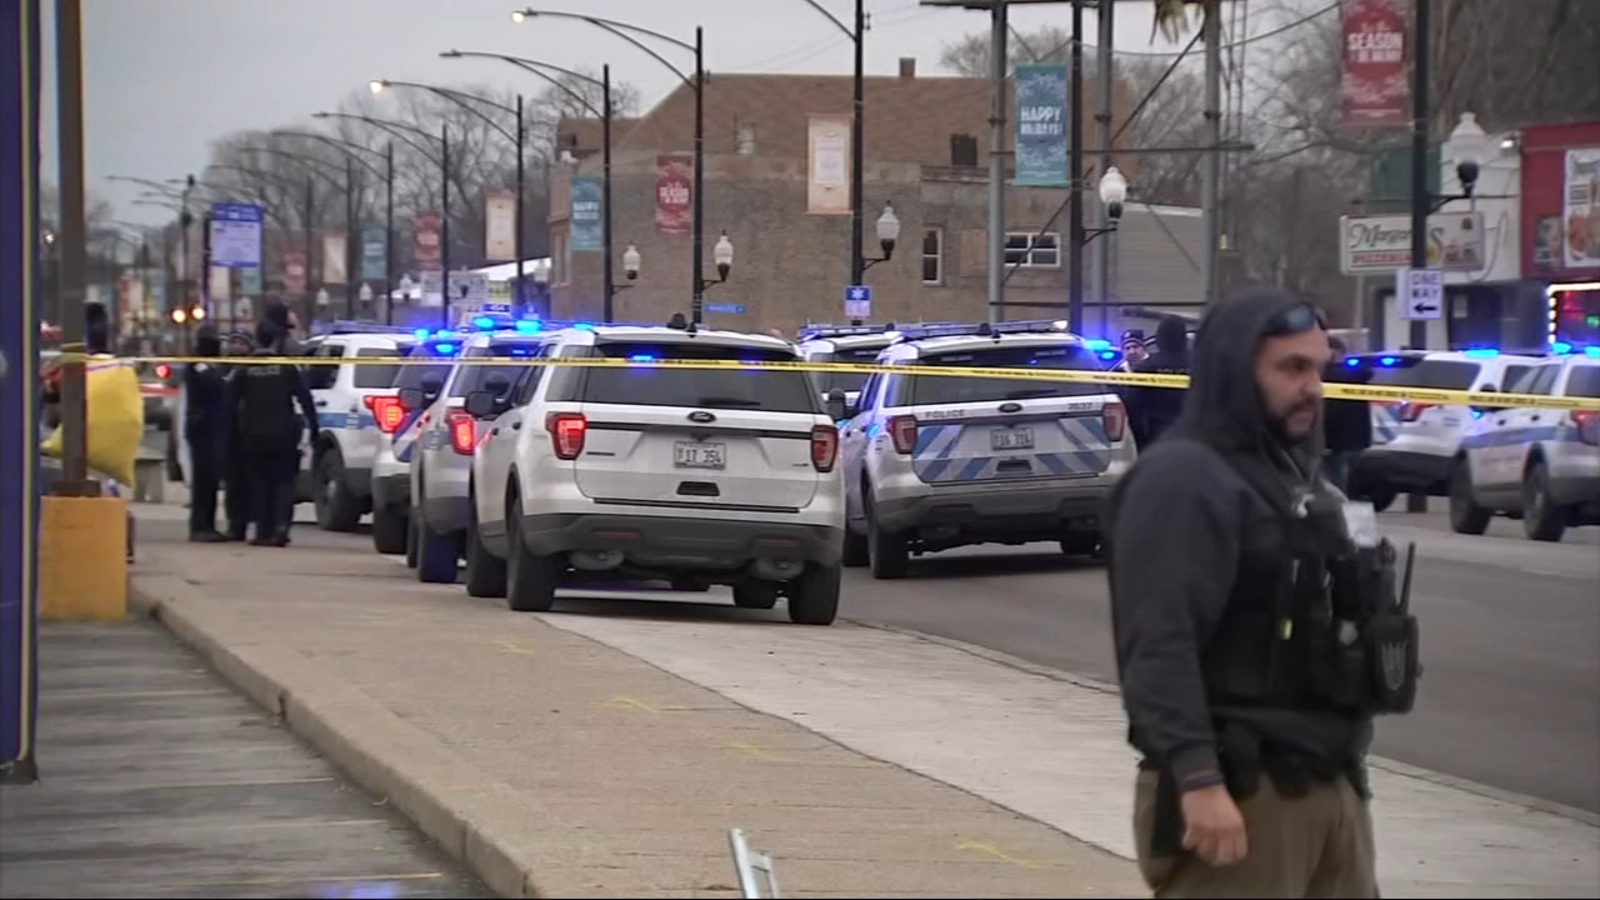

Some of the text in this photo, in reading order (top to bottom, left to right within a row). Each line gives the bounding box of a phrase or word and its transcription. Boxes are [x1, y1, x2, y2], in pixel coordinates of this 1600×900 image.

[1348, 32, 1403, 50] SEASON
[1020, 106, 1061, 121] HAPPY
[1412, 273, 1439, 285] ONE
[1412, 288, 1439, 300] WAY
[924, 409, 965, 419] POLICE
